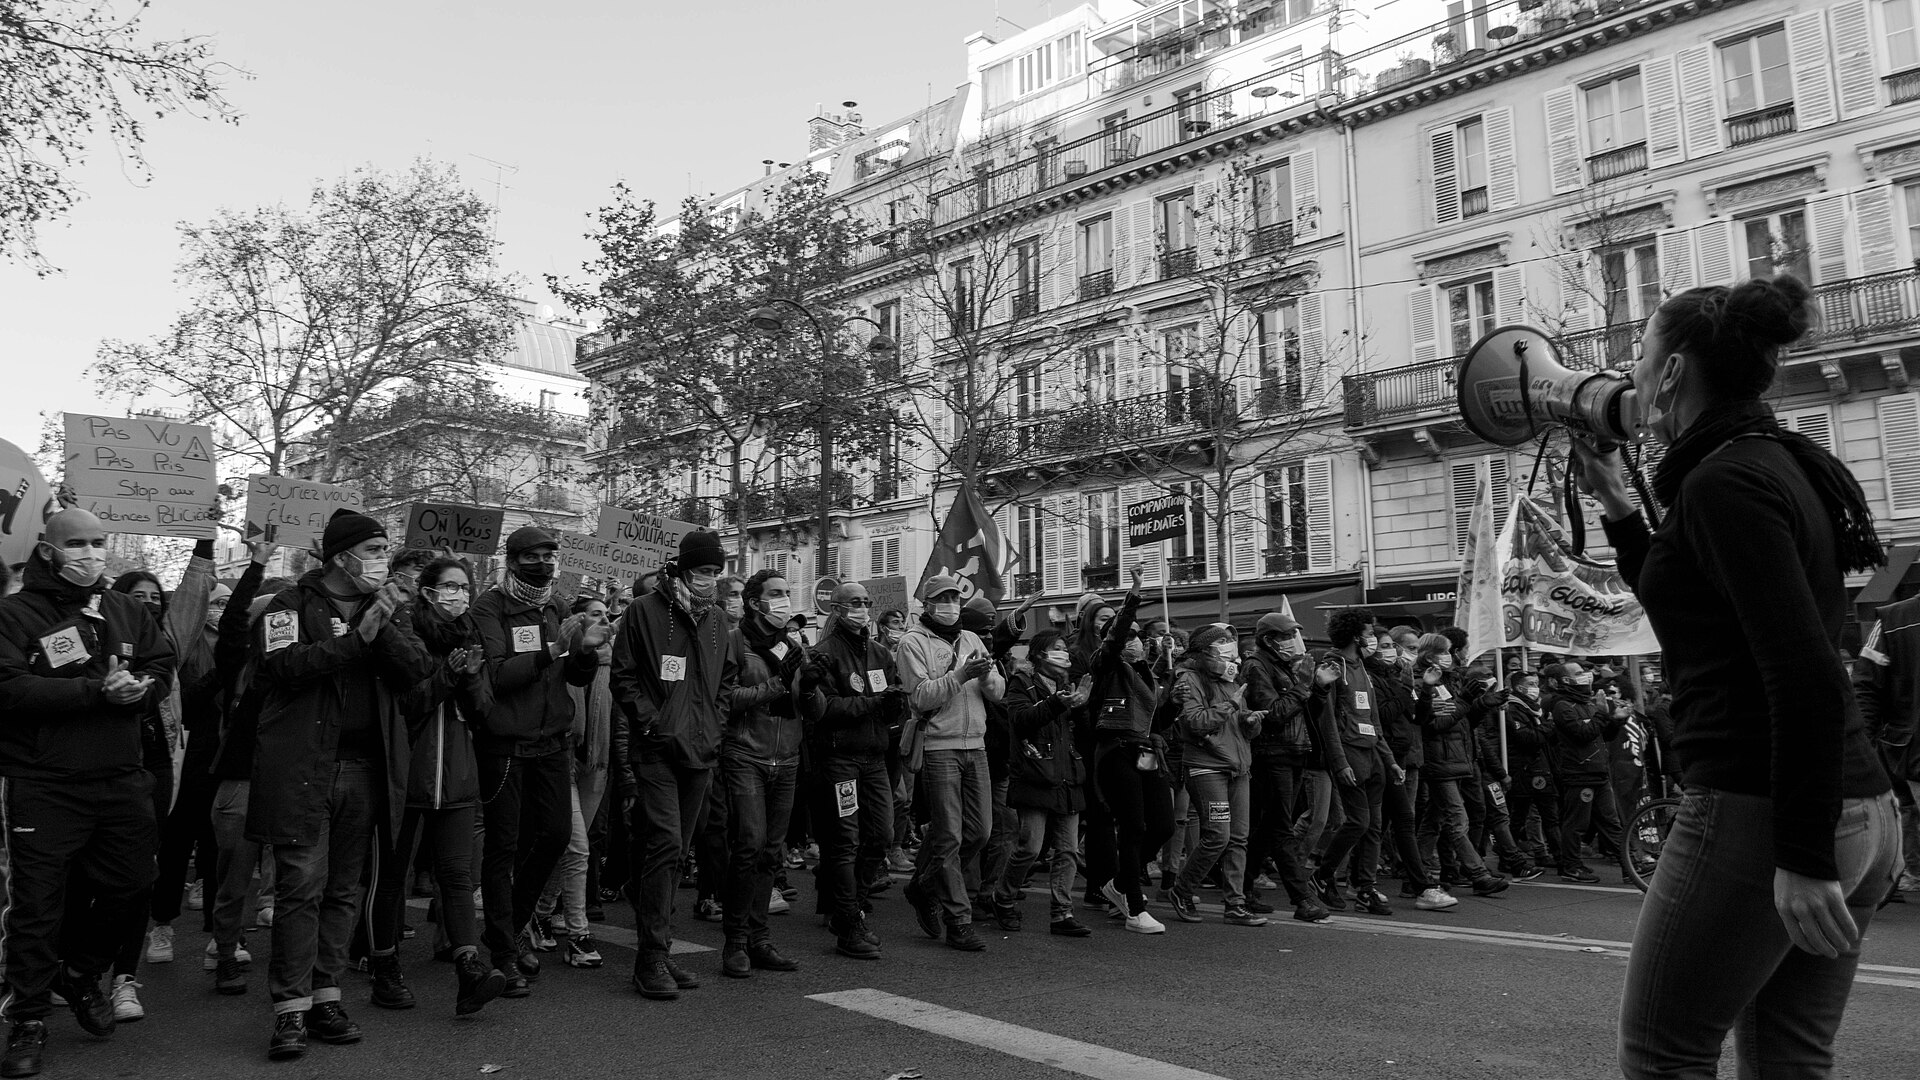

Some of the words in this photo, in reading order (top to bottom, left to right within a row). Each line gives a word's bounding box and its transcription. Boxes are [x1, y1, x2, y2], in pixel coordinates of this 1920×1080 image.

[117, 479, 159, 503] Stop
[169, 487, 195, 496] aux
[632, 513, 651, 525] NON
[651, 517, 663, 529] AU
[611, 548, 658, 568] GLOBALE
